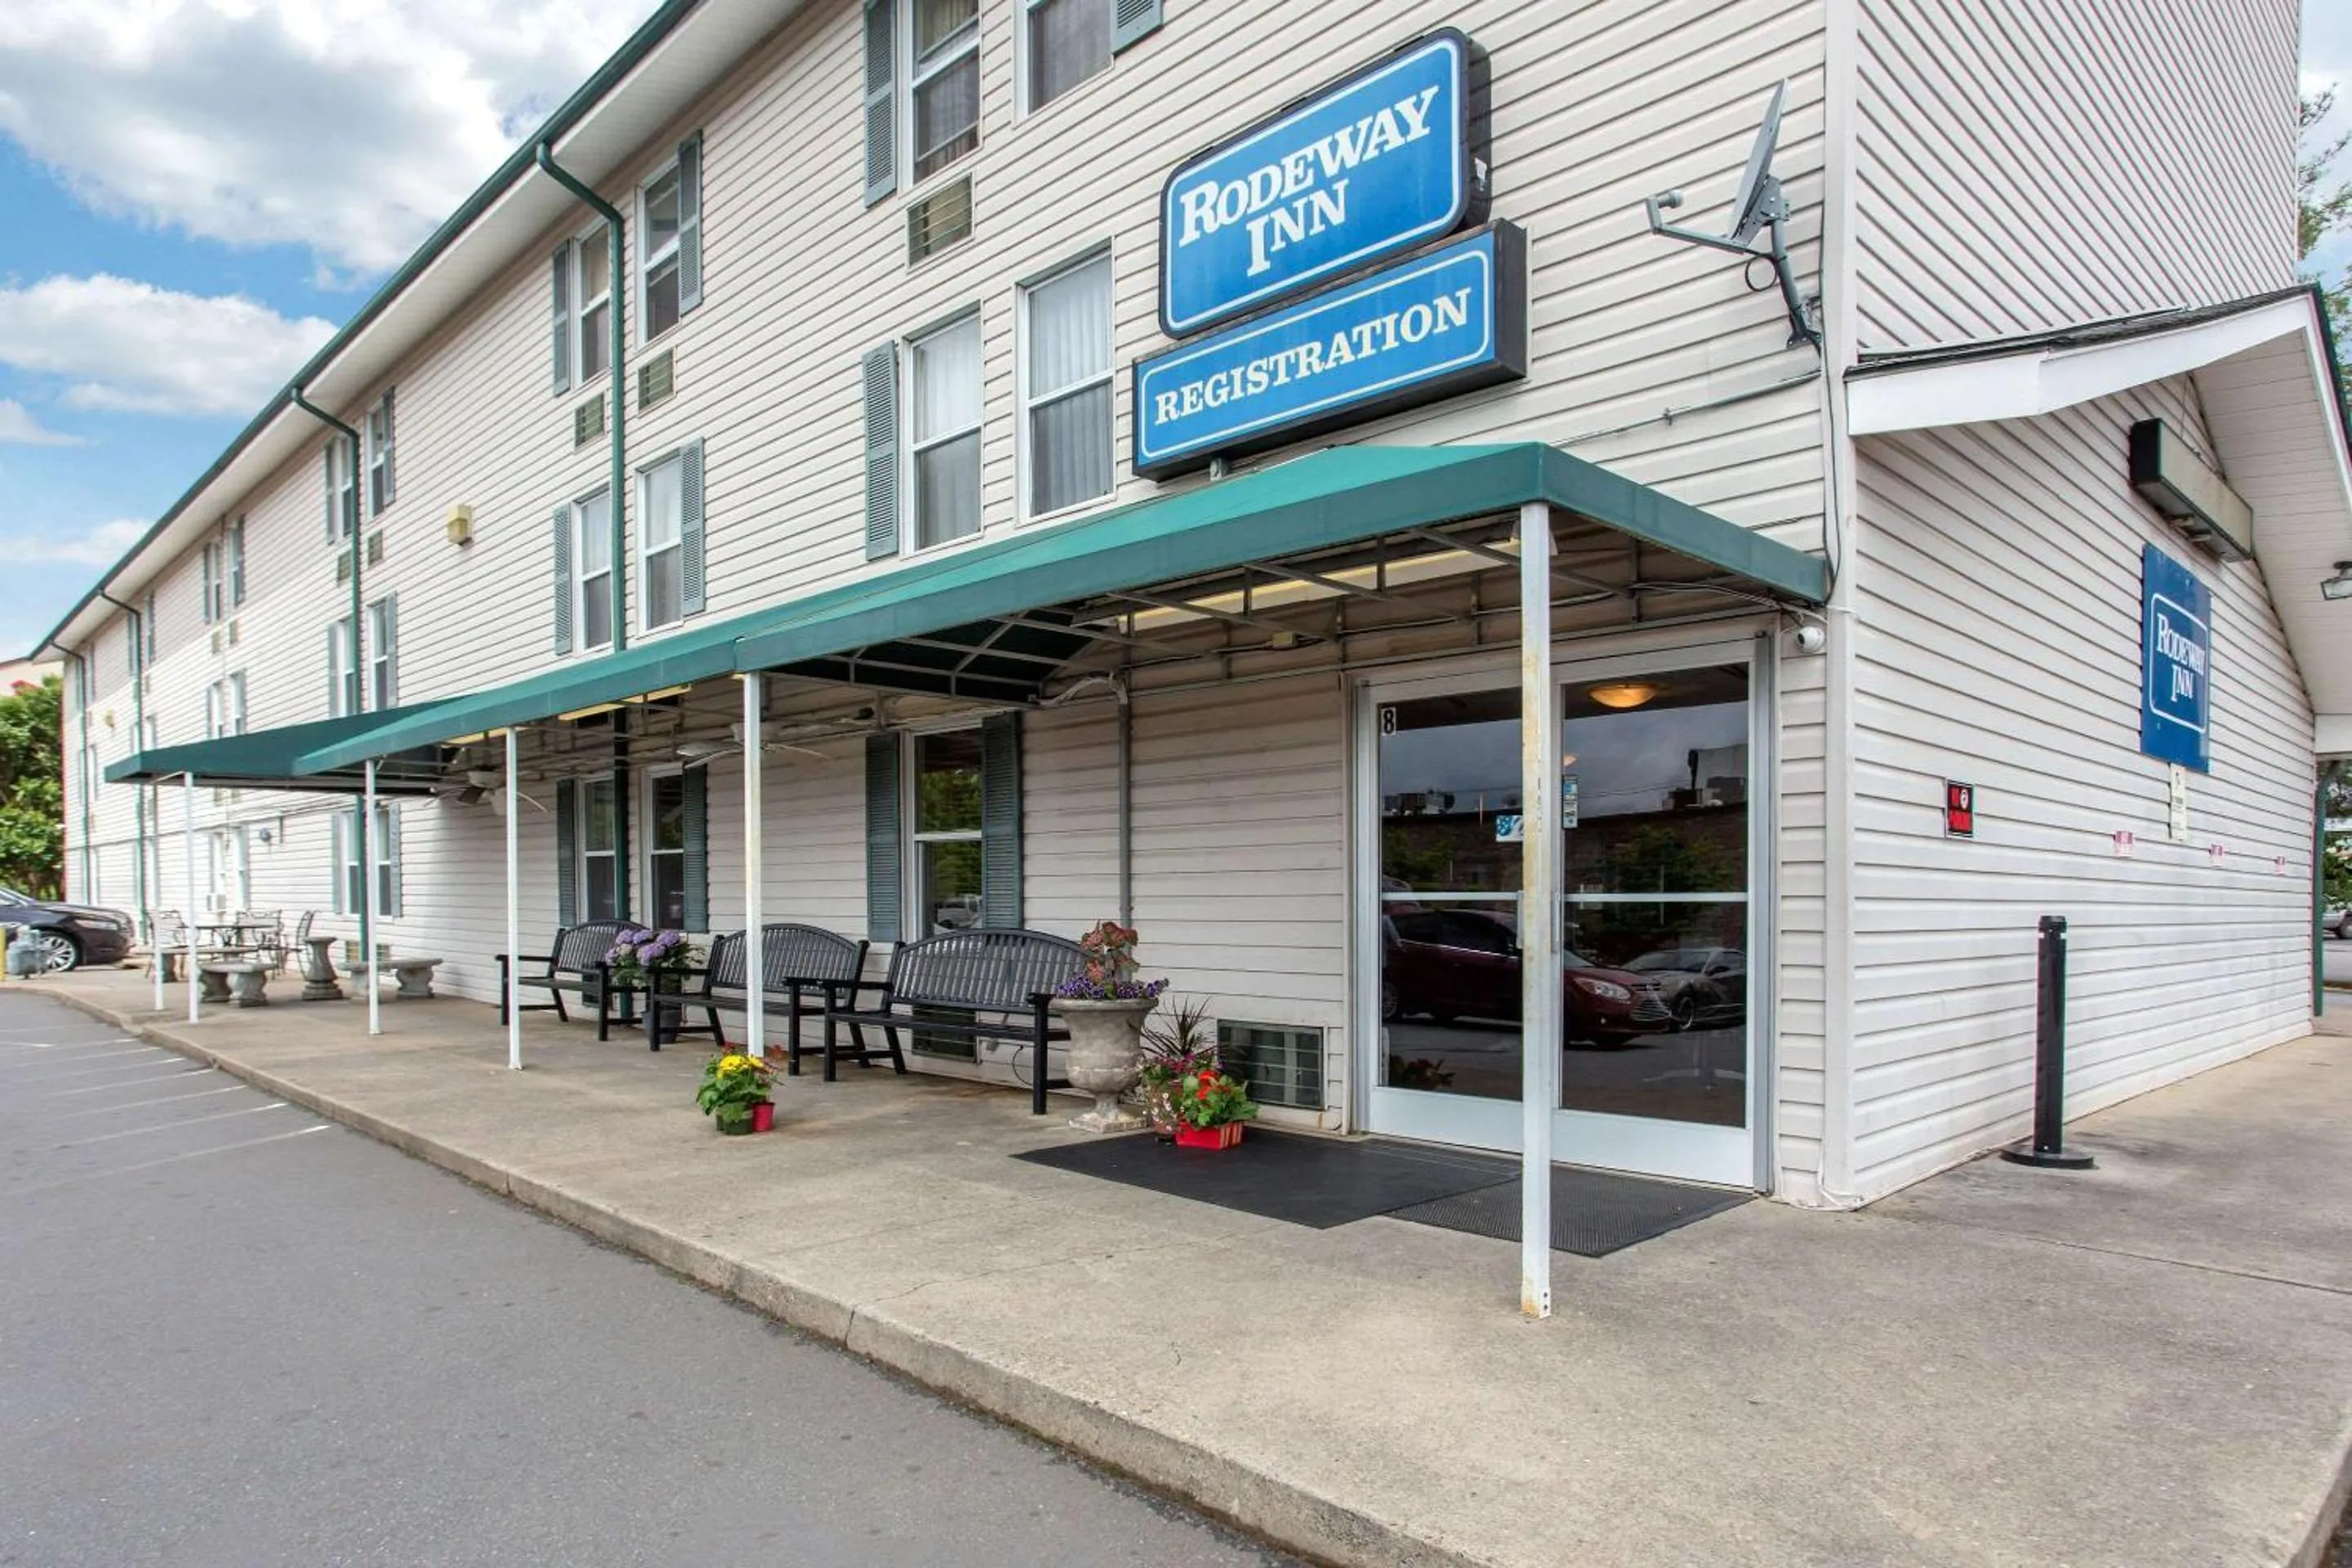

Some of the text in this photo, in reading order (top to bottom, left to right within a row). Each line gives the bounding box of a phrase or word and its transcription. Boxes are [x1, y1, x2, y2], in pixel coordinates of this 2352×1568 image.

[1178, 85, 1440, 247] RODEWAY
[1245, 179, 1349, 277] INN
[1154, 287, 1472, 425] REGISTRATION
[1383, 709, 1395, 734] 8
[2171, 664, 2194, 702] INN
